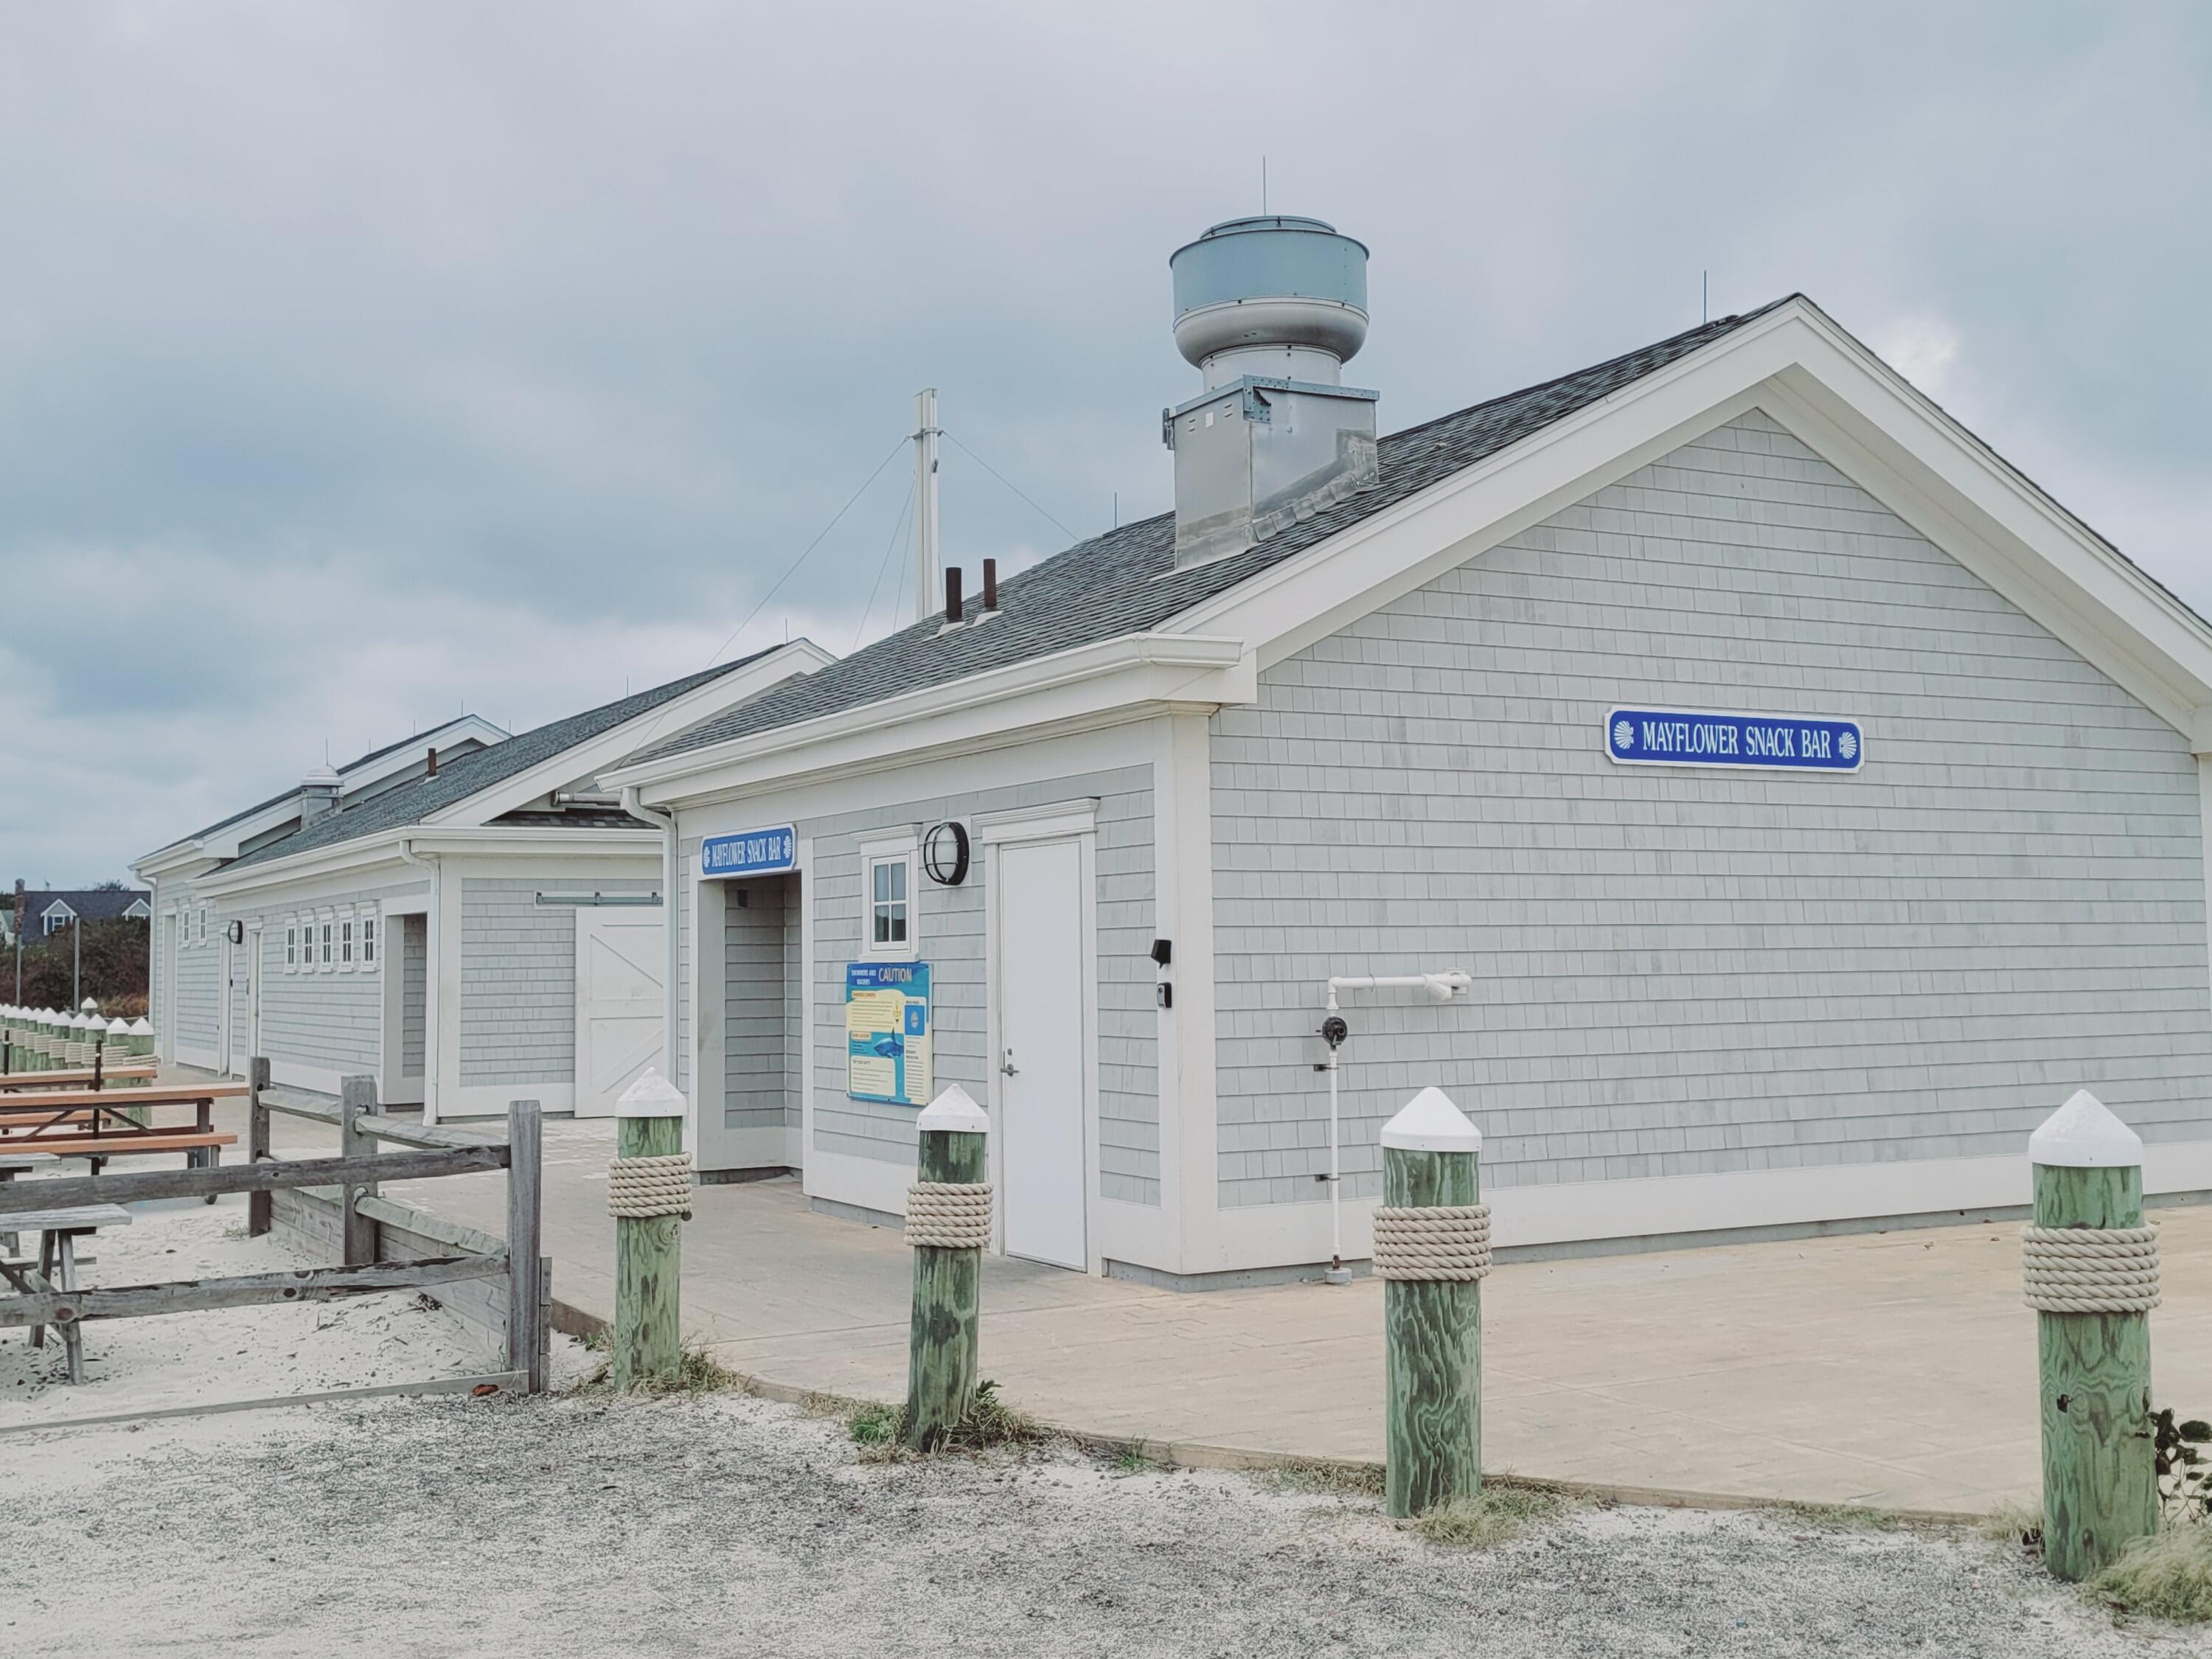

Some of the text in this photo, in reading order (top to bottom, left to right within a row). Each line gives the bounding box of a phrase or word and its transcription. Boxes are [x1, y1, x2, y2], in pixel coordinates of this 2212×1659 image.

[1642, 721, 1832, 759] MAYFLOWER SNACK BAR
[712, 836, 781, 867] MAYFLOWER SNACK BAR
[878, 967, 912, 982] CAUTION
